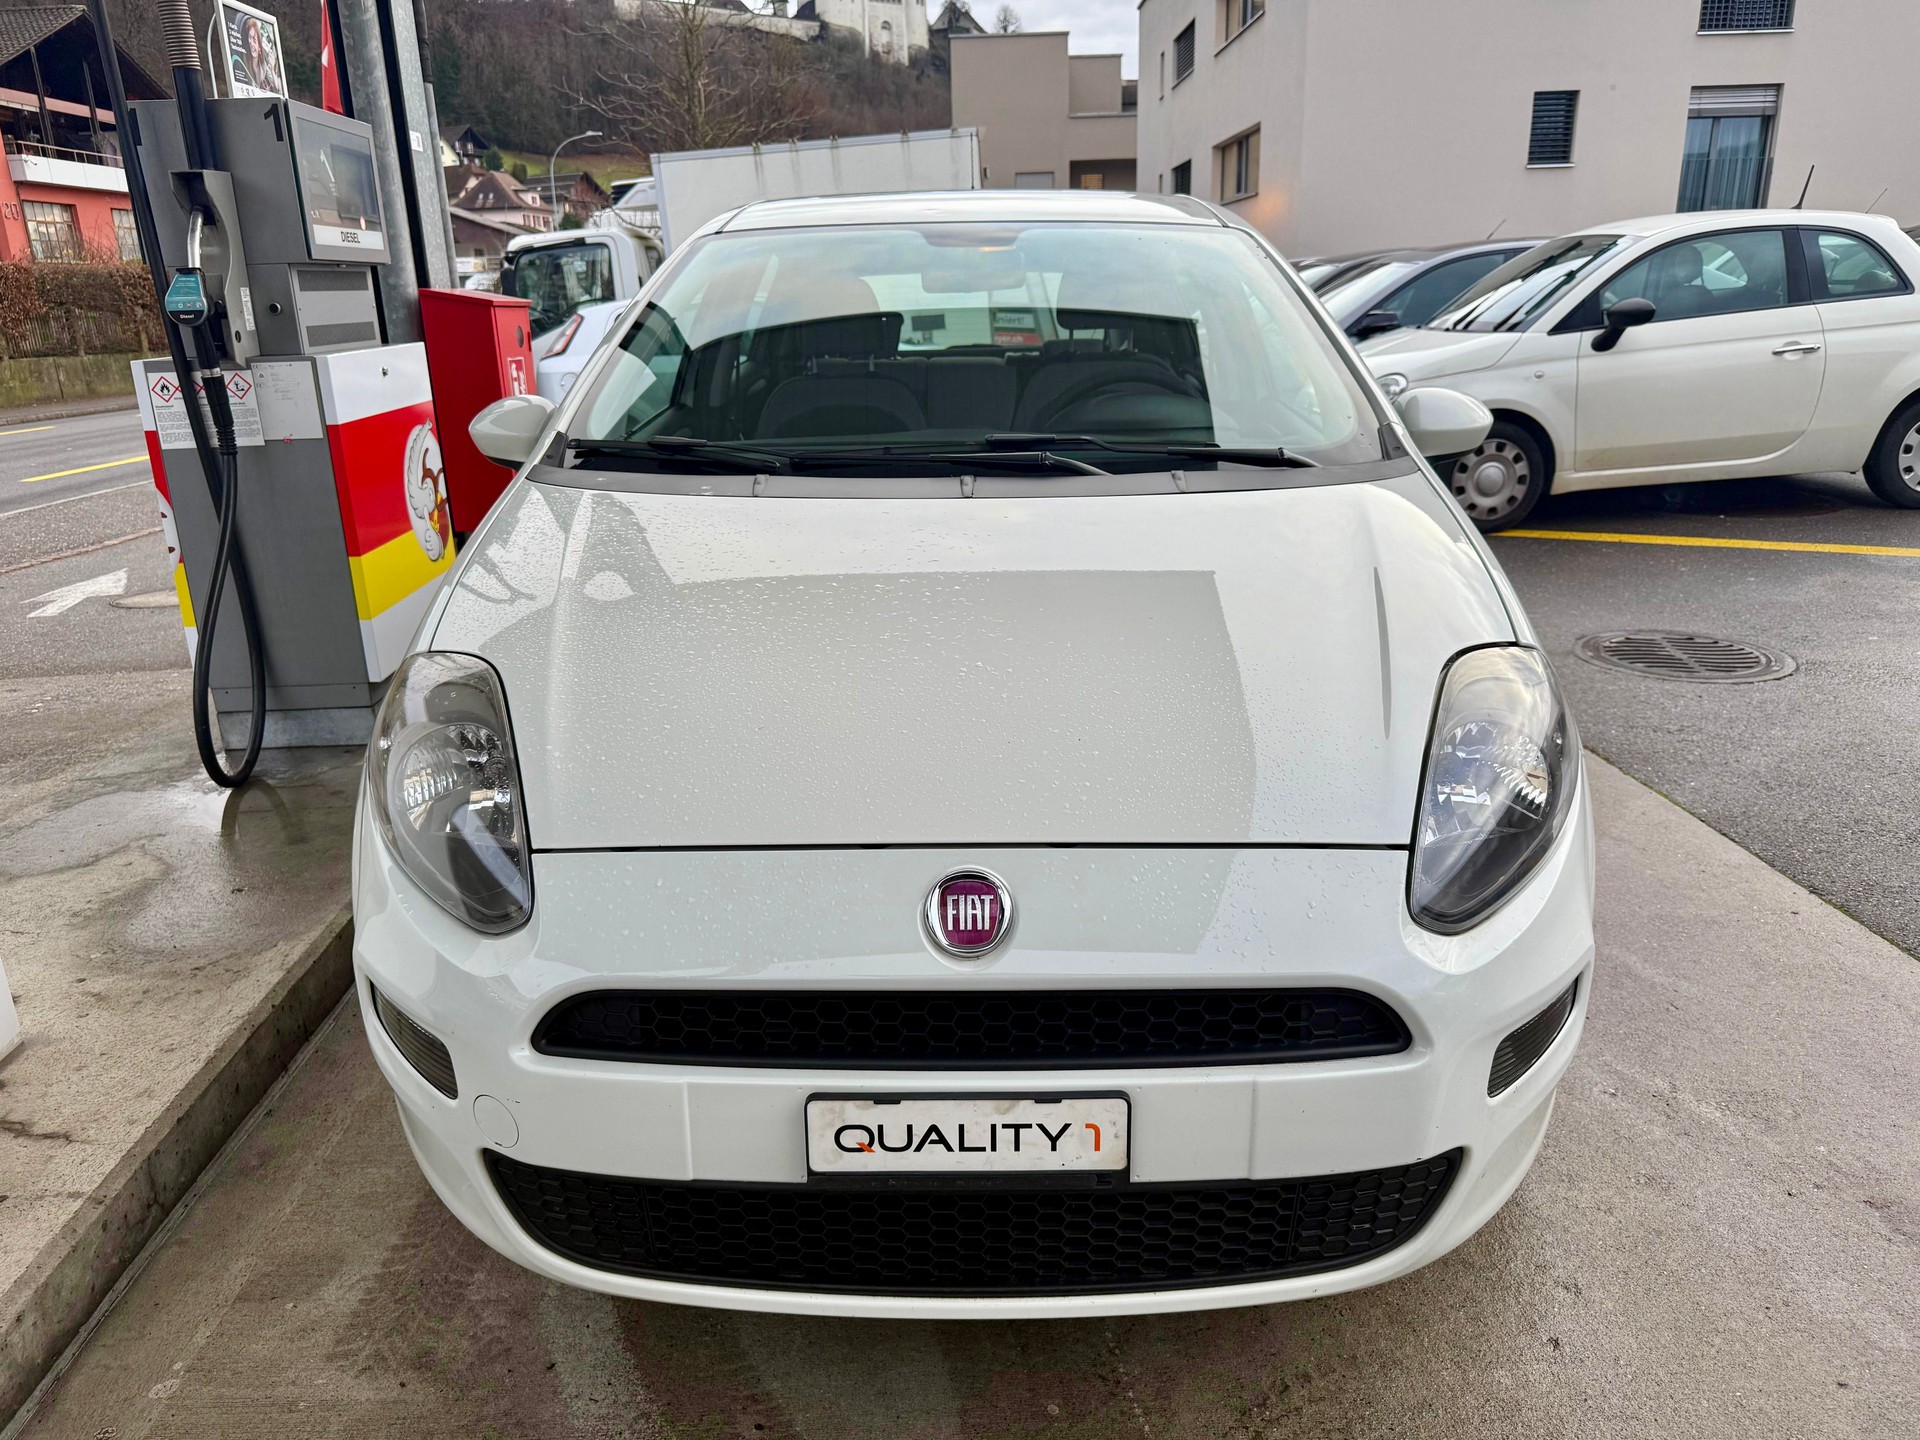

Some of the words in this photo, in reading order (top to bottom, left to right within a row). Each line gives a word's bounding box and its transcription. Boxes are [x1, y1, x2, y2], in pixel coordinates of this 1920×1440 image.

[263, 103, 284, 142] 1
[340, 231, 361, 244] DIESEL
[946, 894, 994, 931] FIAT
[834, 1123, 1073, 1153] QUALITY
[1085, 1123, 1101, 1152] 1
